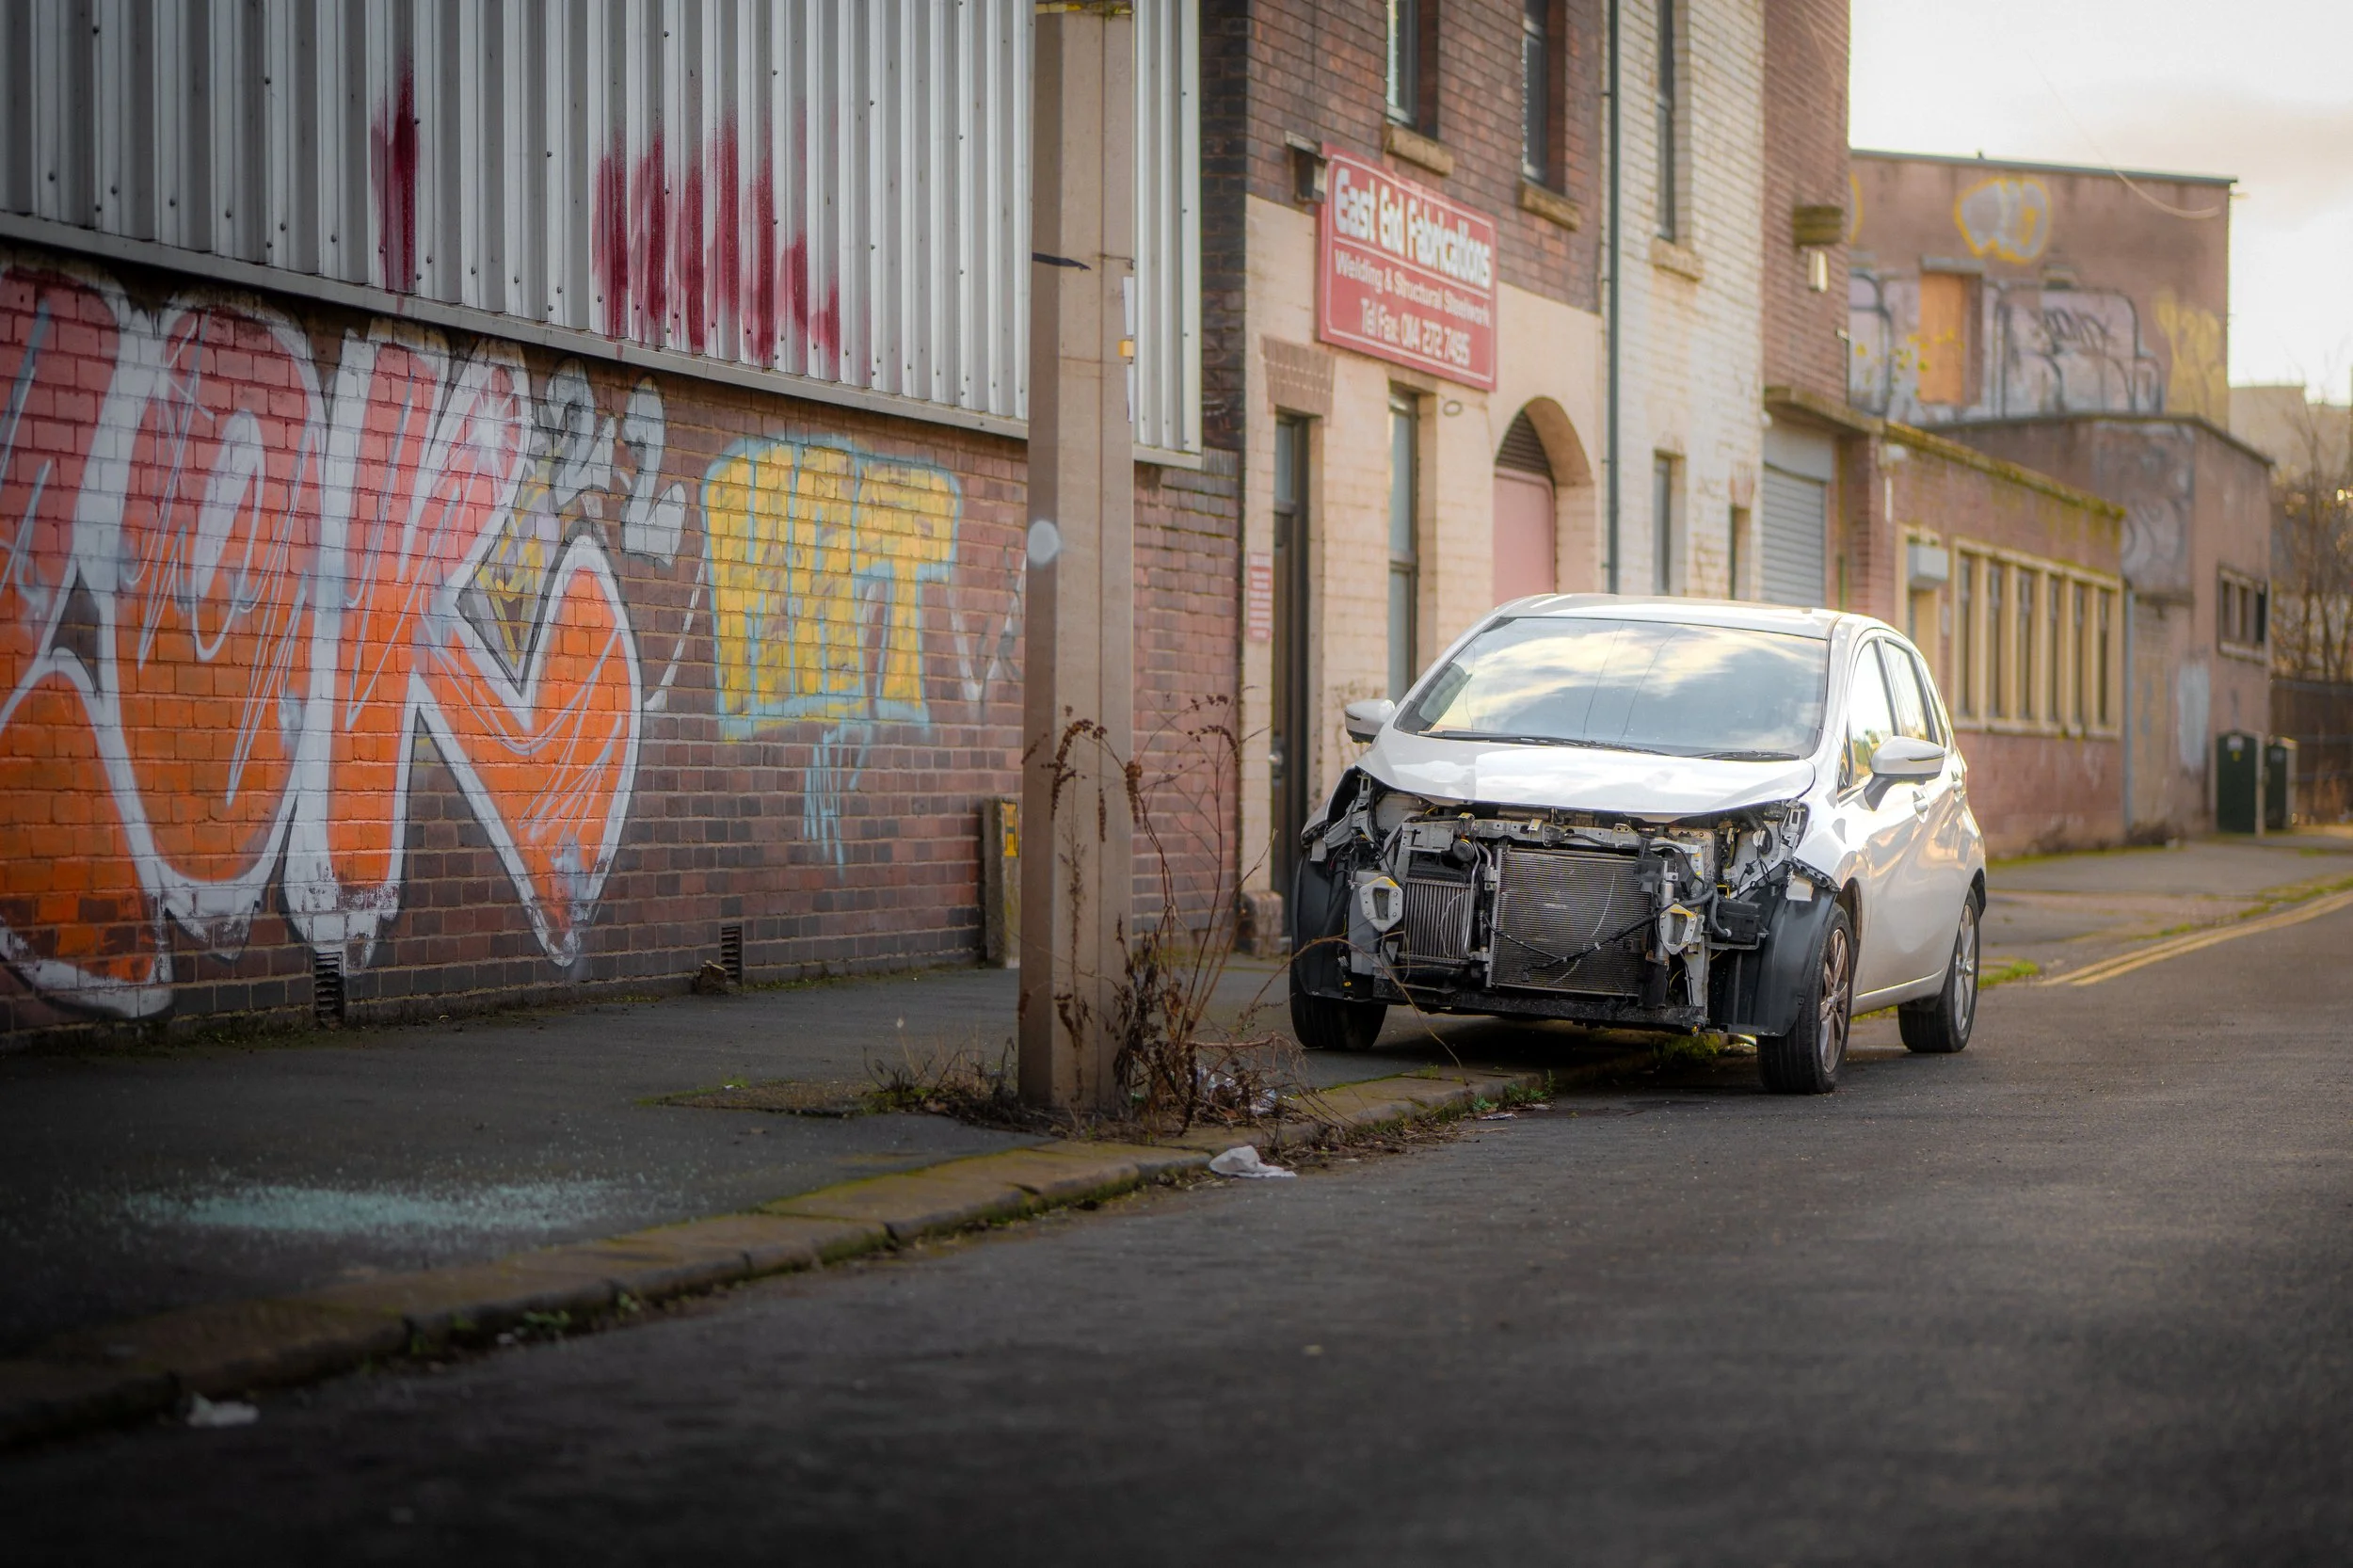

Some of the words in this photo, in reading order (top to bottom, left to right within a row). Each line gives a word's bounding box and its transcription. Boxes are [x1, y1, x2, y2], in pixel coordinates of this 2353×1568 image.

[1335, 168, 1376, 244] East
[1379, 184, 1404, 257] End
[1407, 198, 1491, 290] Fabrications
[1335, 248, 1384, 295] Welding
[1385, 266, 1392, 293] &
[1394, 270, 1443, 311] Structural
[1422, 318, 1443, 360] 272
